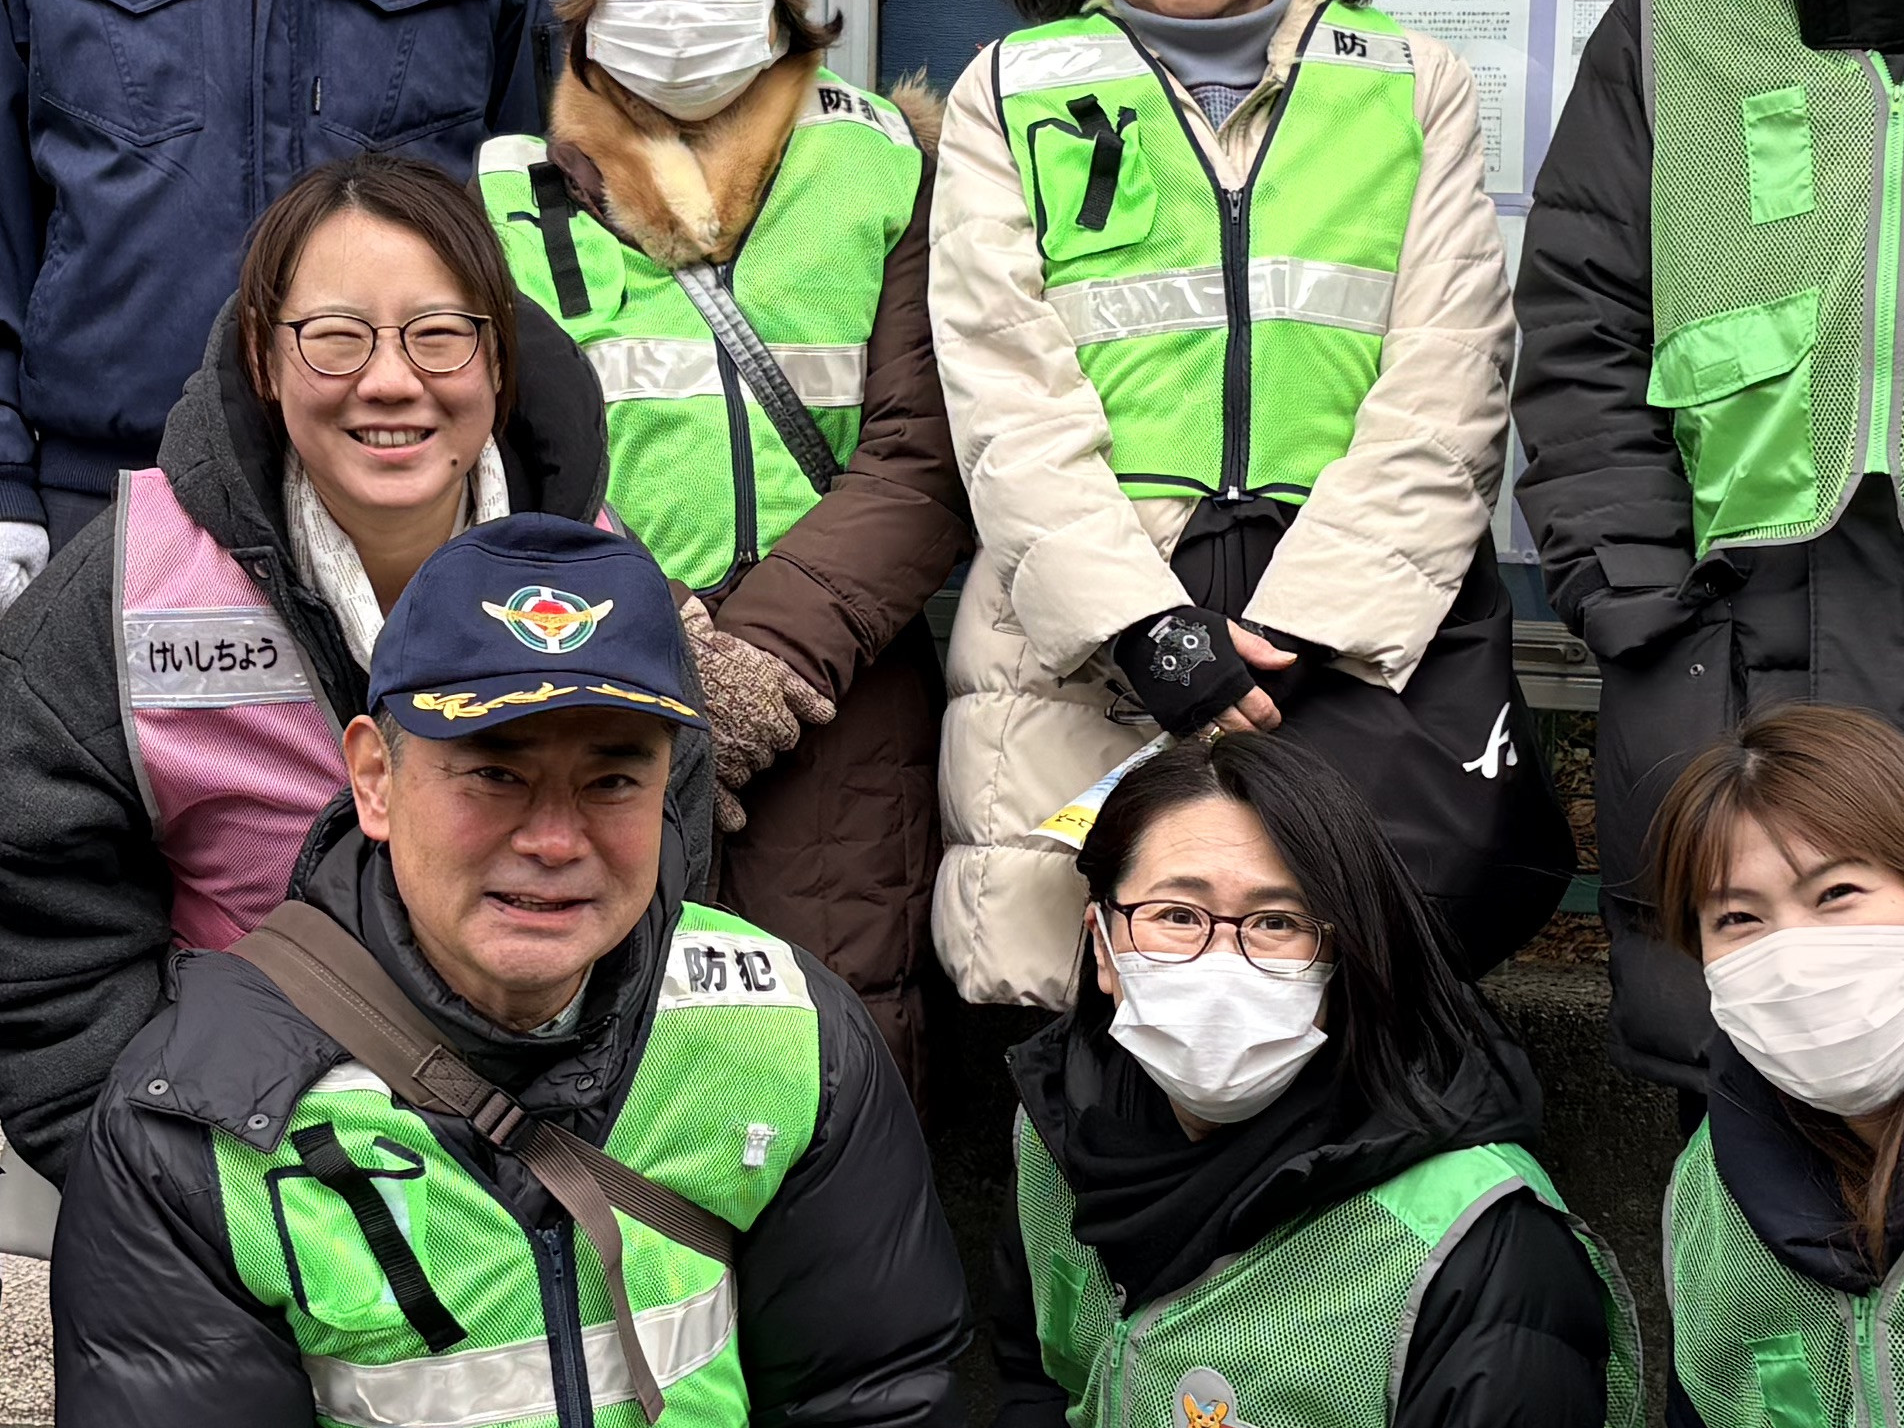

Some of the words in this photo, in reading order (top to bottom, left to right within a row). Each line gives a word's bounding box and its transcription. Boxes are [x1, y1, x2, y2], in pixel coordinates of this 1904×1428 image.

[150, 637, 278, 673] けいしちょう
[683, 946, 777, 993] 防犯
